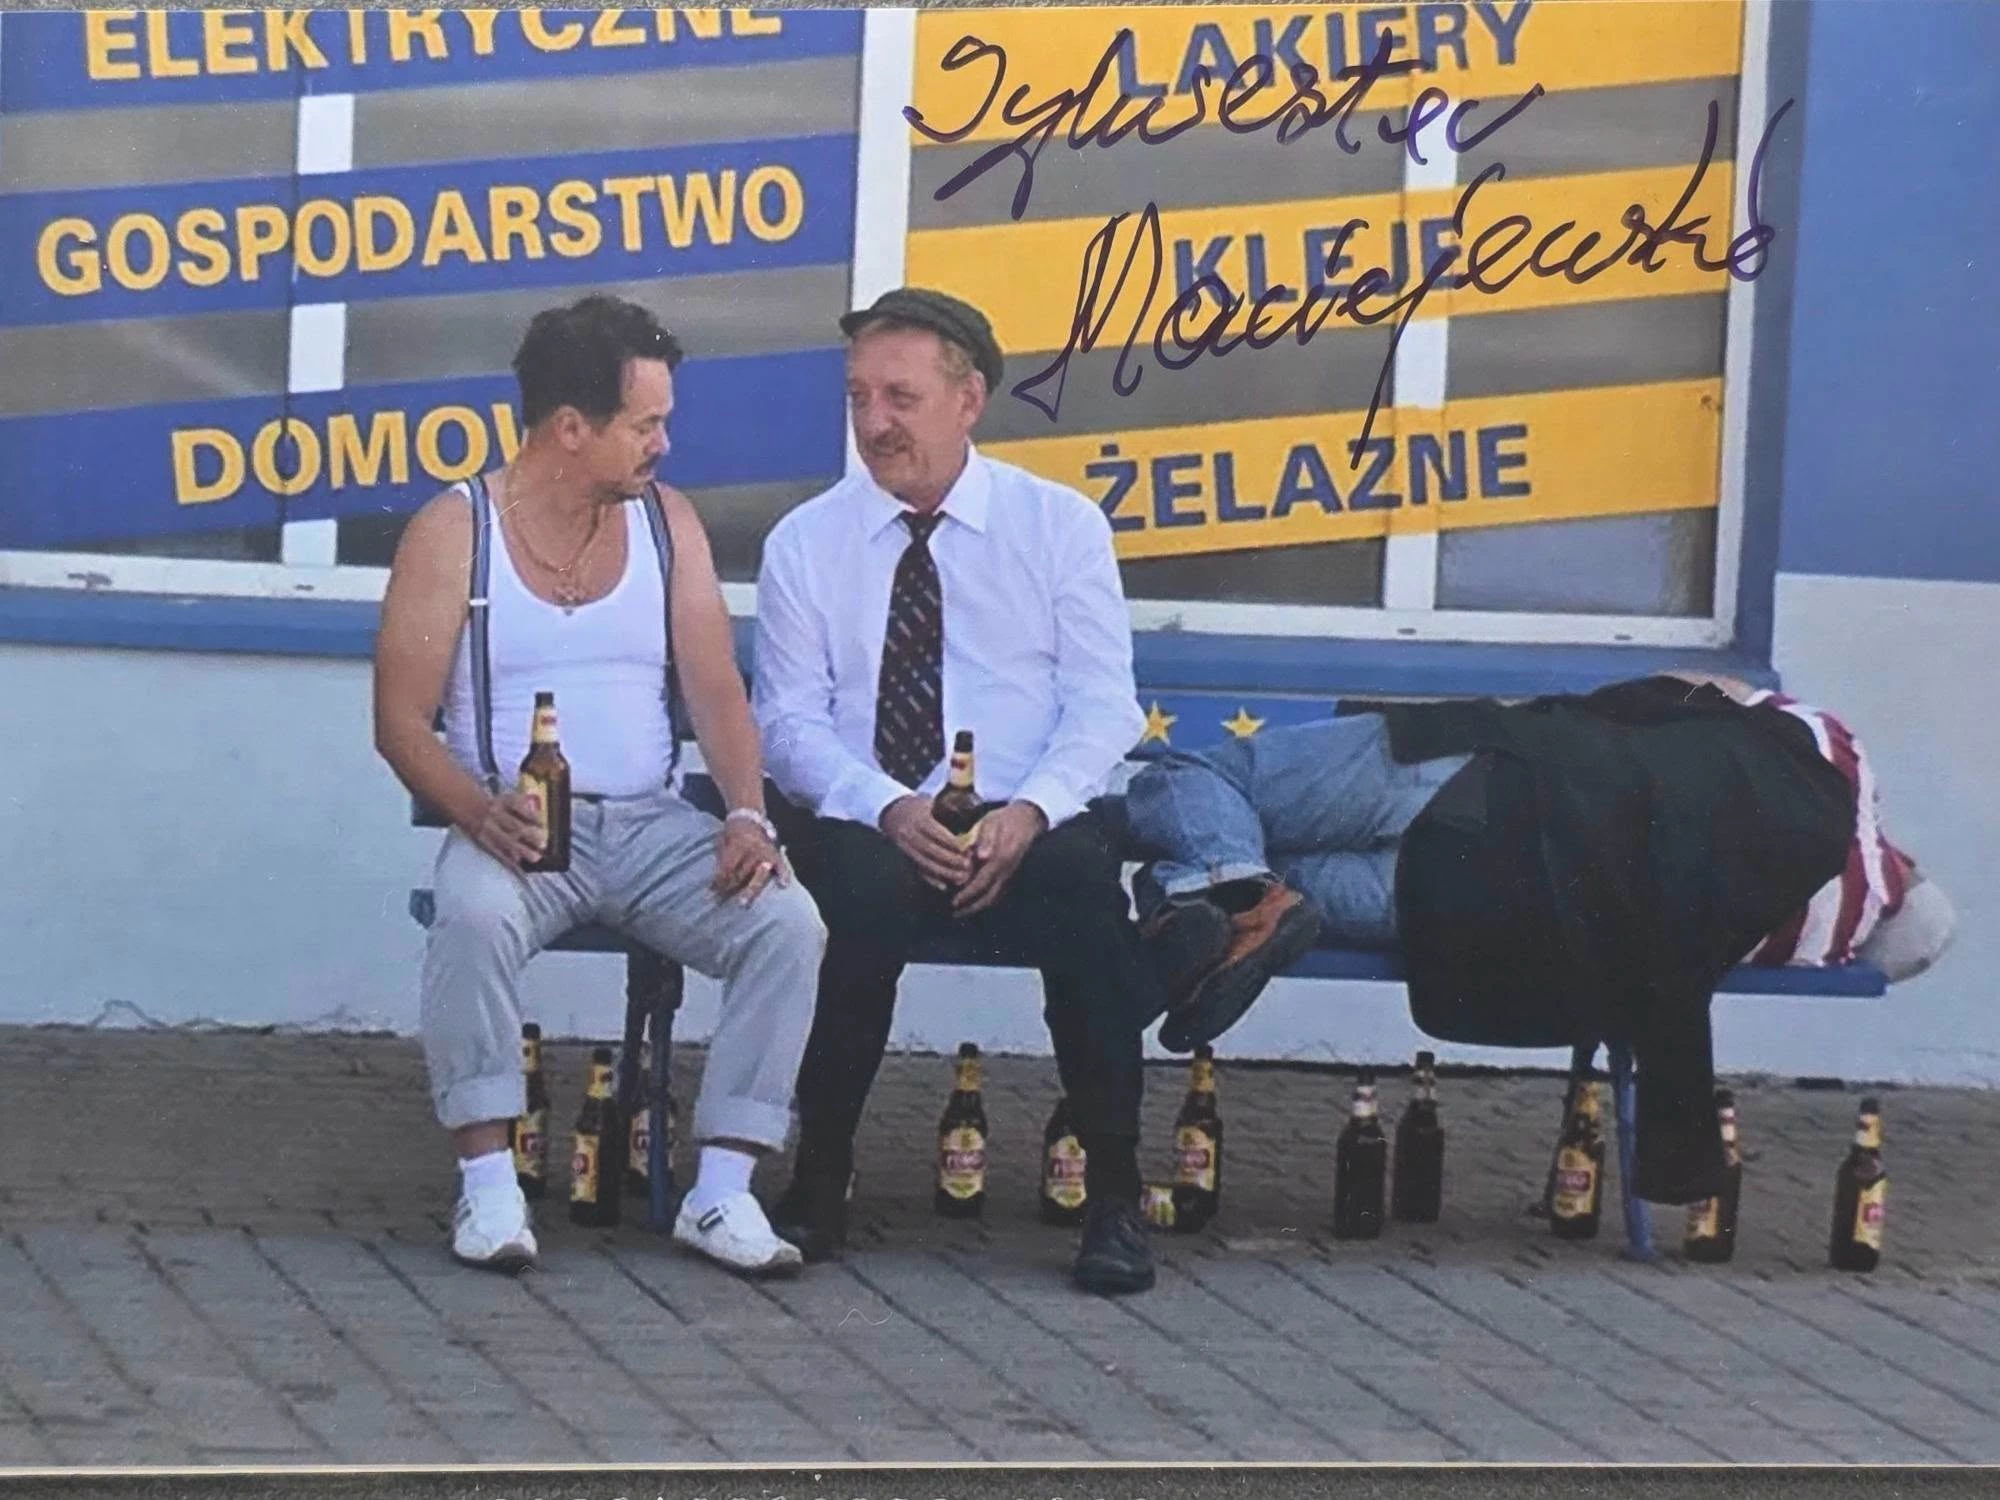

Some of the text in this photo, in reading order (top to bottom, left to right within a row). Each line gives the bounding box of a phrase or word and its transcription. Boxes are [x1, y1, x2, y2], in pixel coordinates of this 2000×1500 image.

[1114, 2, 1532, 100] LAKIERY
[37, 165, 805, 296] GOSPODARSTWO
[1172, 216, 1466, 306] KLEJE
[1084, 423, 1532, 532] ŻELAZNE
